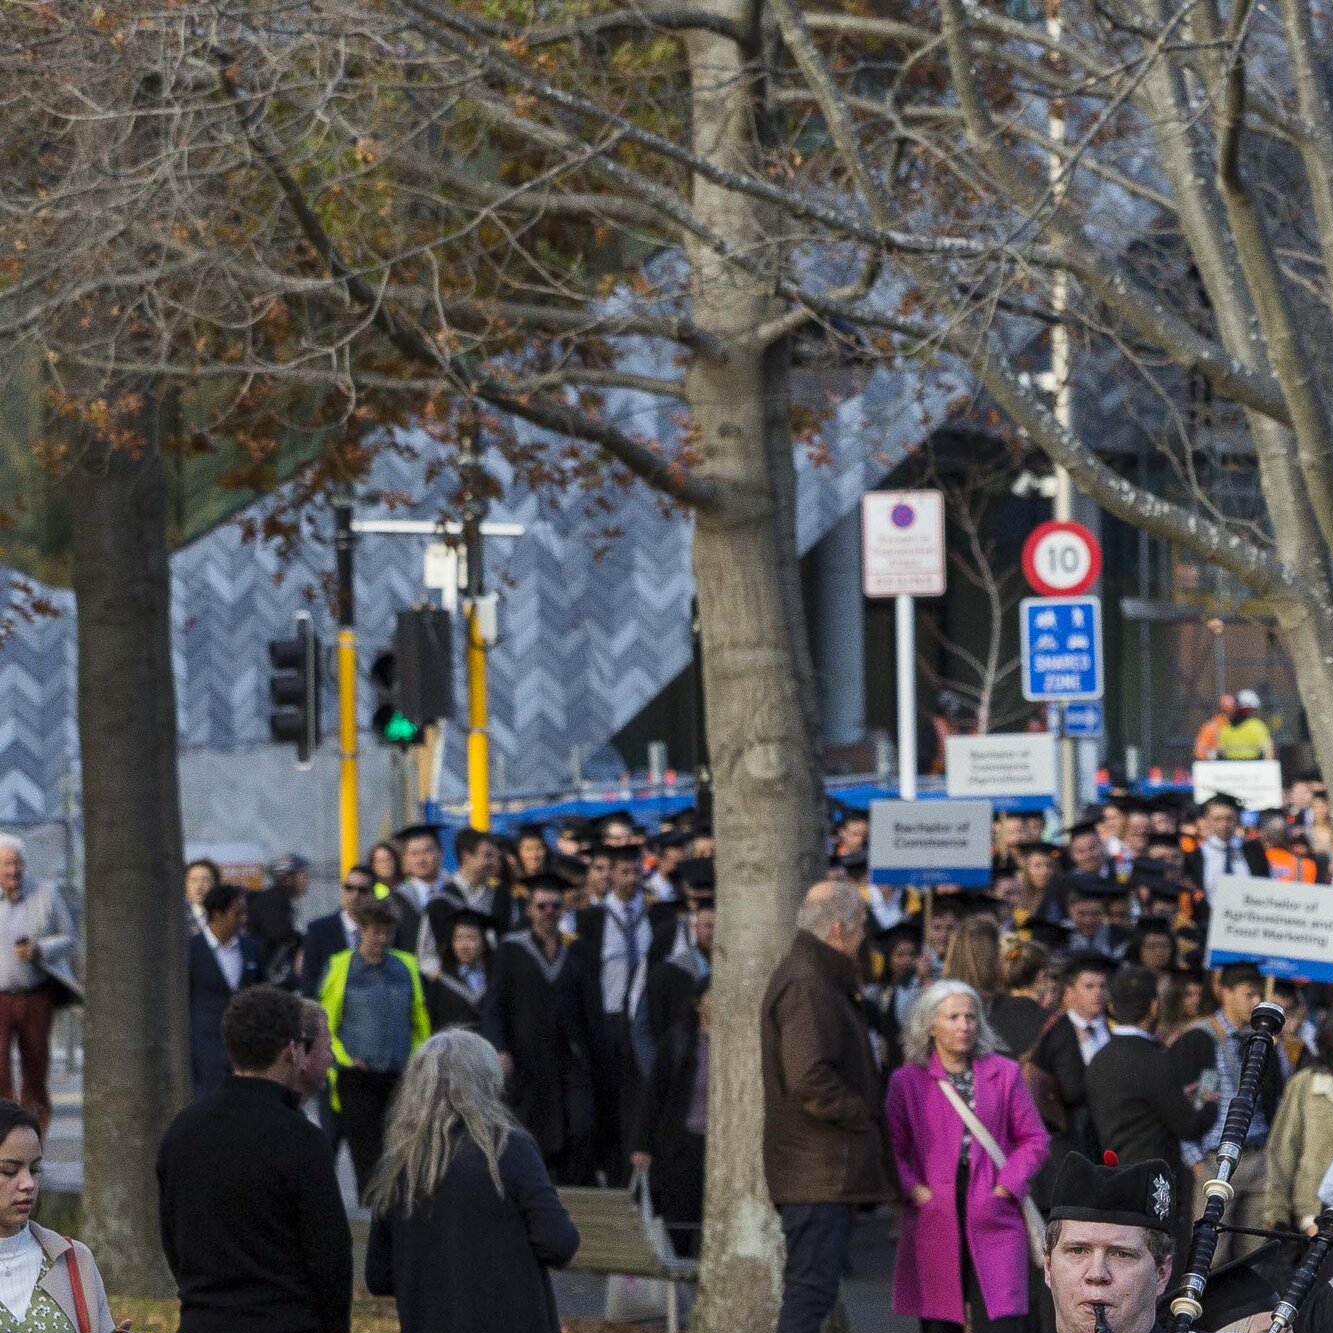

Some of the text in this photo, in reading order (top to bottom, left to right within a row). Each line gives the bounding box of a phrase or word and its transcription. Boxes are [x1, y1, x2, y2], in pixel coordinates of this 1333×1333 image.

[1048, 546, 1080, 574] 10
[894, 821, 971, 833] Bachelor of
[894, 838, 968, 850] Commerce
[1244, 894, 1319, 912] Bachelor of
[1224, 909, 1307, 926] Agribusiness
[1225, 925, 1328, 947] Food Marketing
